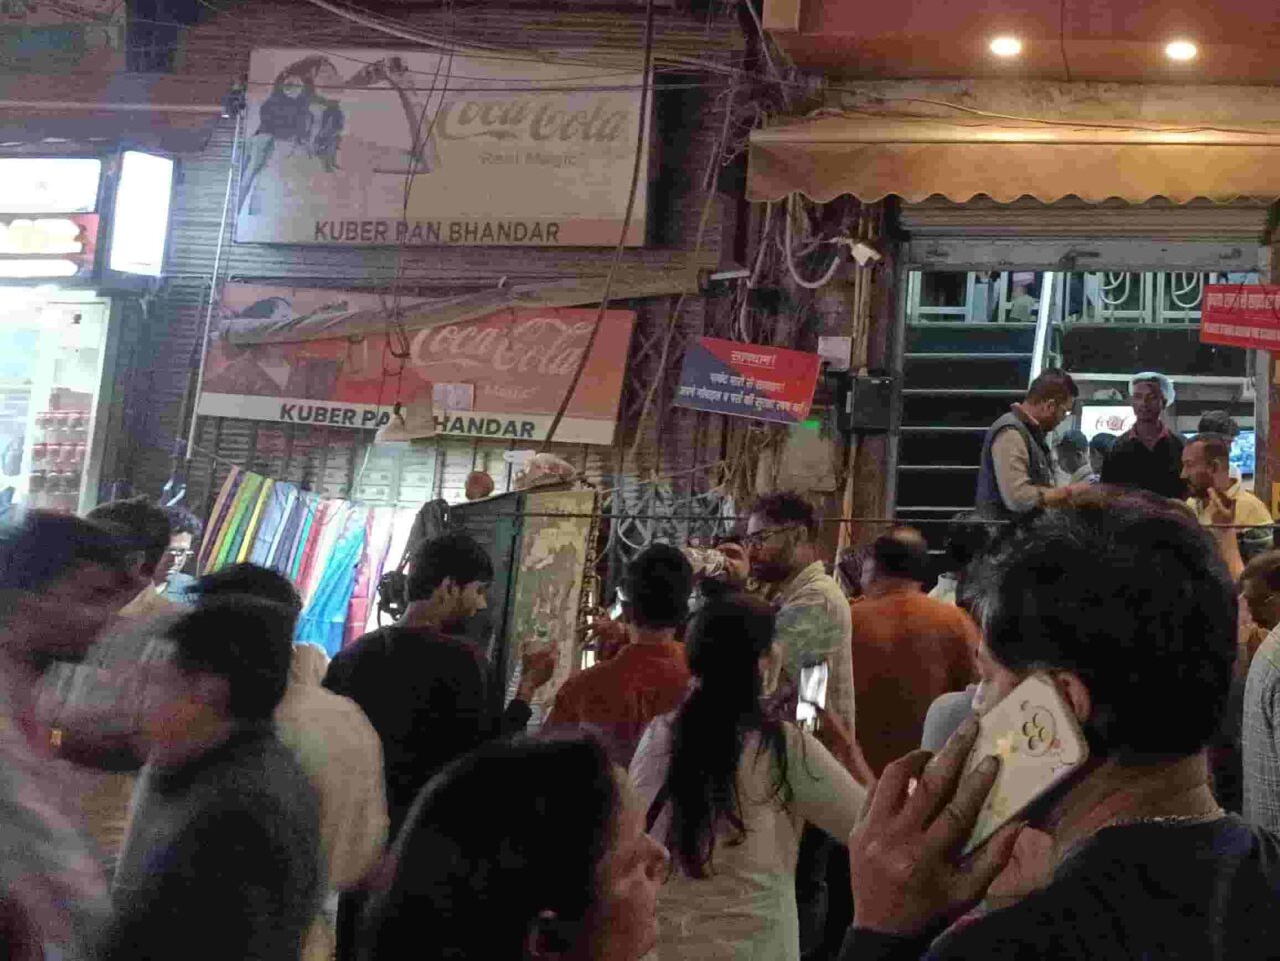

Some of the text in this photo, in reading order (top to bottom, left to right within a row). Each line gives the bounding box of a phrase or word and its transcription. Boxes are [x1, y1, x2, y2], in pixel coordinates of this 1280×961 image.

[314, 221, 560, 242] KUBER PAN BHANDAR
[280, 403, 359, 425] KUBER
